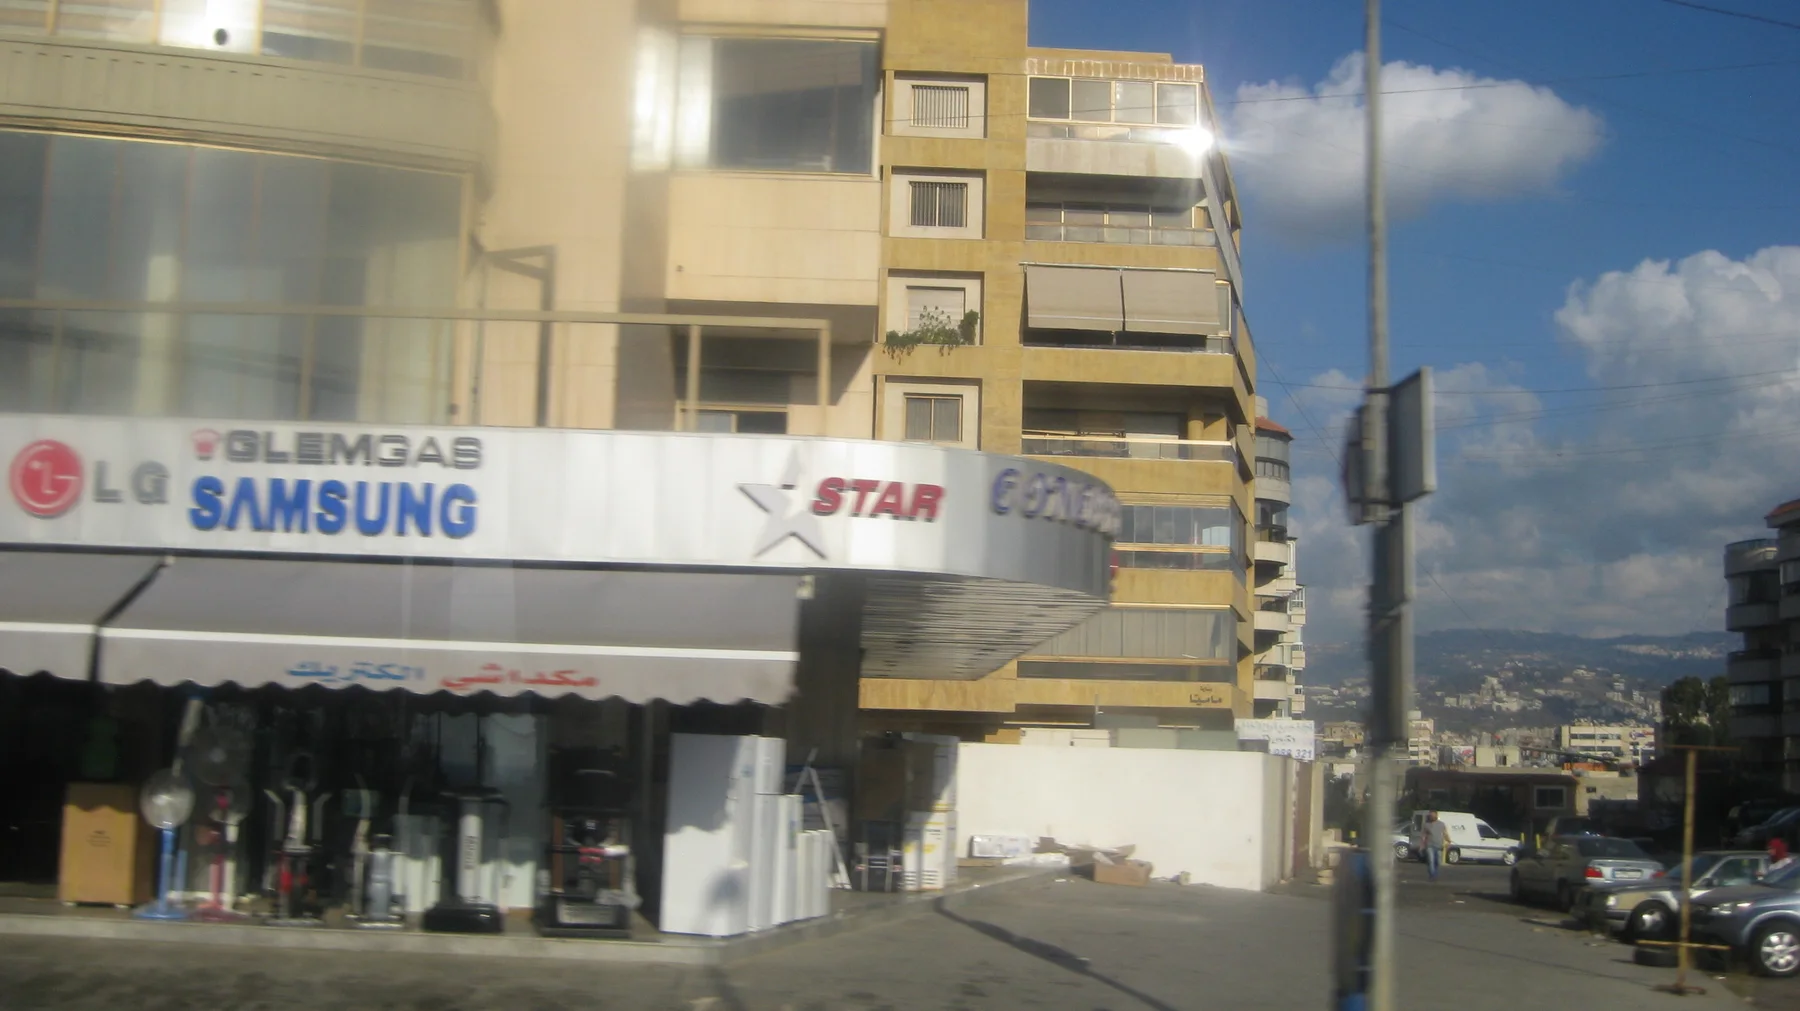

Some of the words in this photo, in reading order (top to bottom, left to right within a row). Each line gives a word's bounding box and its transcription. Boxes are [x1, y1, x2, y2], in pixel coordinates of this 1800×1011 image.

[226, 429, 482, 469] GLEMGAS
[93, 460, 170, 505] LG
[811, 477, 946, 522] STAR
[188, 475, 478, 539] SAMSUNG
